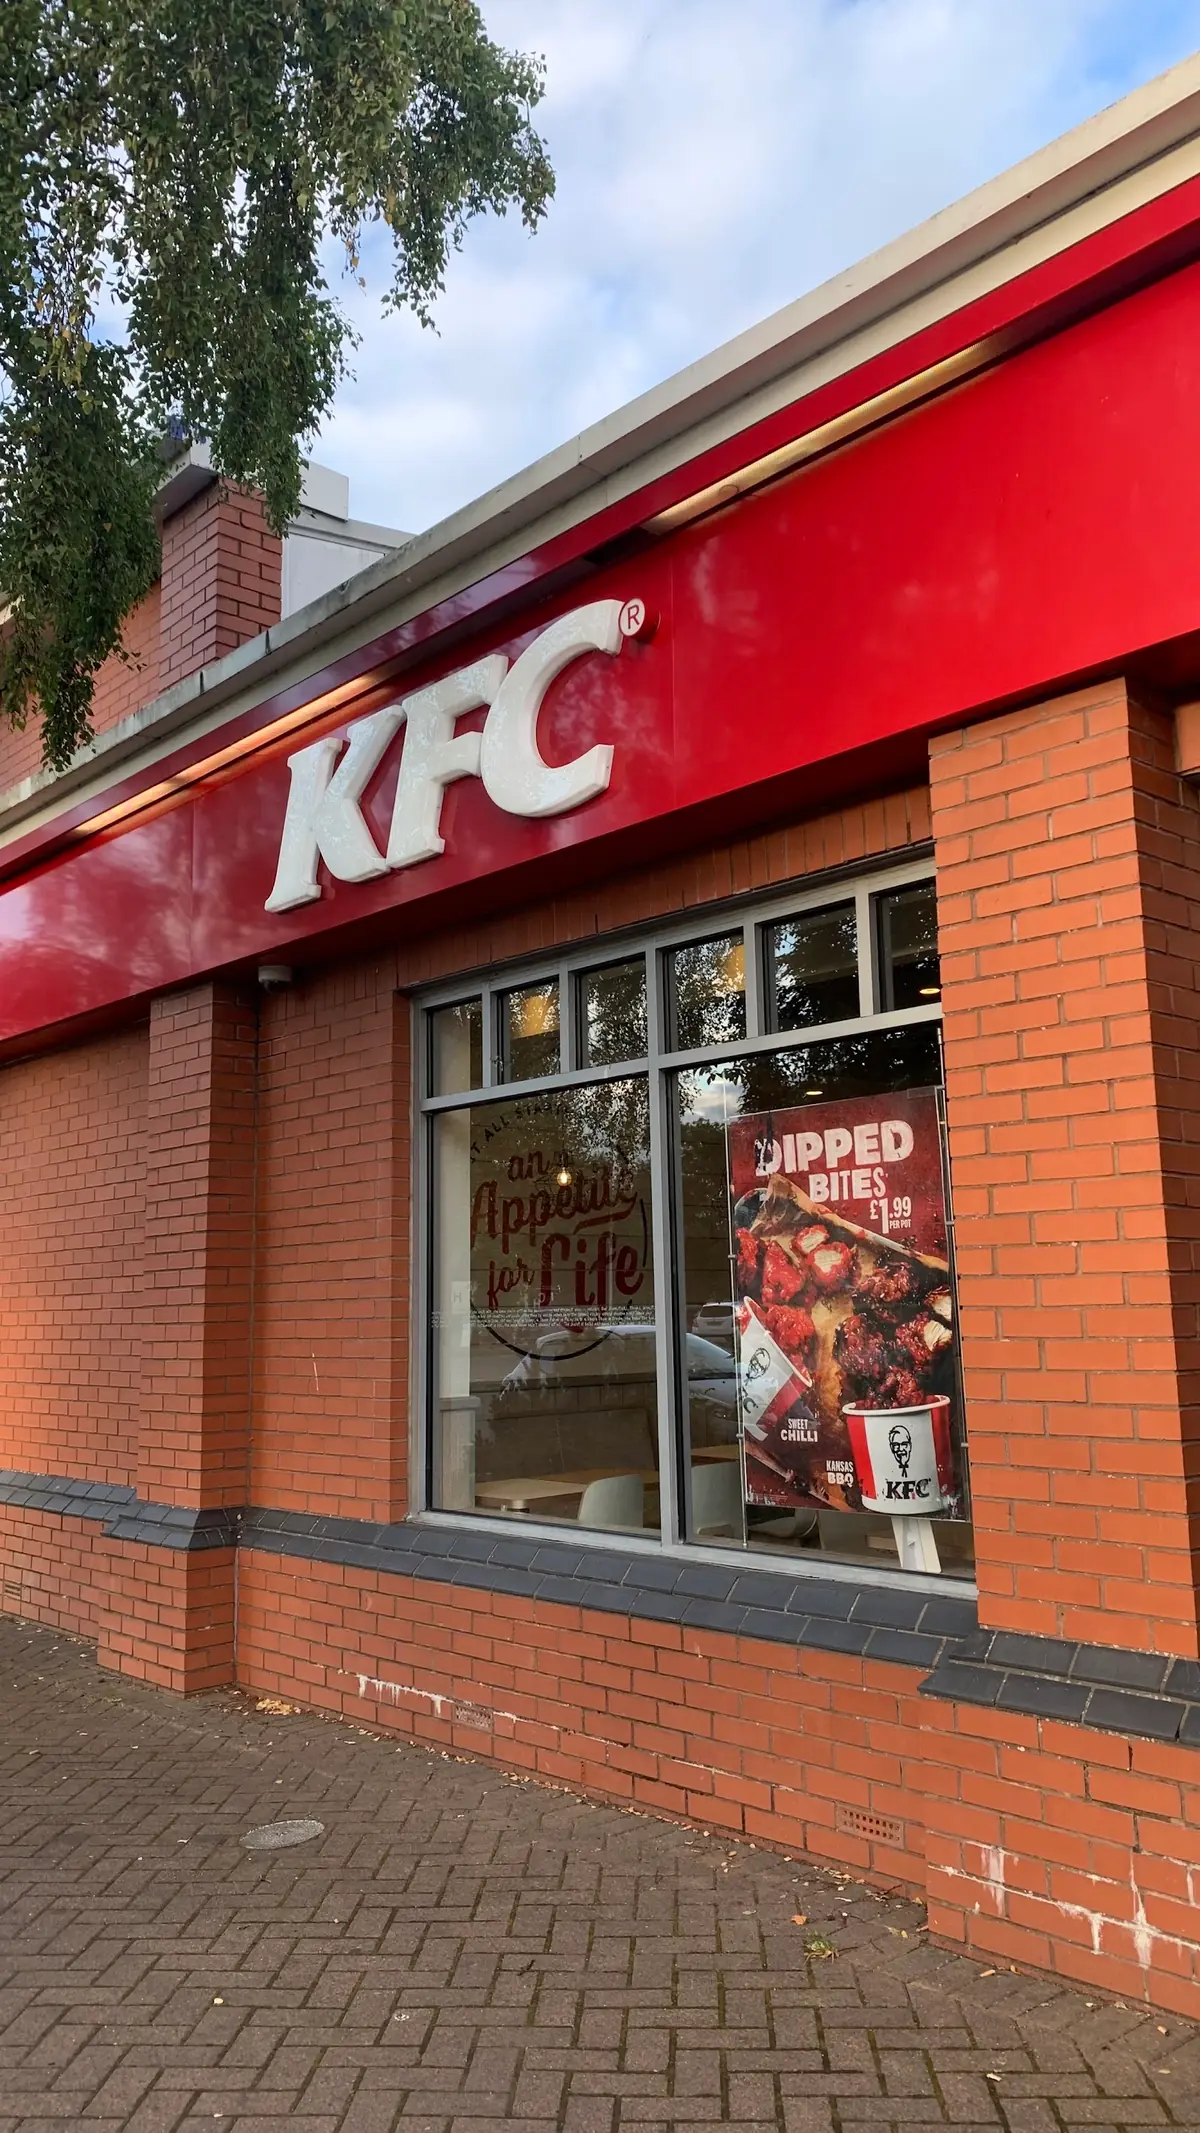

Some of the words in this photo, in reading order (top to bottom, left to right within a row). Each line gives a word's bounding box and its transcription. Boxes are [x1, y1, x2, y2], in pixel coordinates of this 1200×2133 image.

[265, 599, 627, 913] KFC
[755, 1120, 914, 1177] DIPPED
[507, 1150, 549, 1182] an
[809, 1167, 887, 1203] BITES
[870, 1196, 912, 1234] £1.99
[890, 1220, 900, 1230] PER
[901, 1219, 911, 1229] POT
[487, 1260, 535, 1310] for
[538, 1232, 645, 1332] Life
[780, 1429, 818, 1443] CHILLI
[788, 1418, 809, 1430] SWEET
[826, 1460, 854, 1473] KANSAS
[827, 1472, 854, 1488] BBQ
[885, 1478, 931, 1500] KFC
